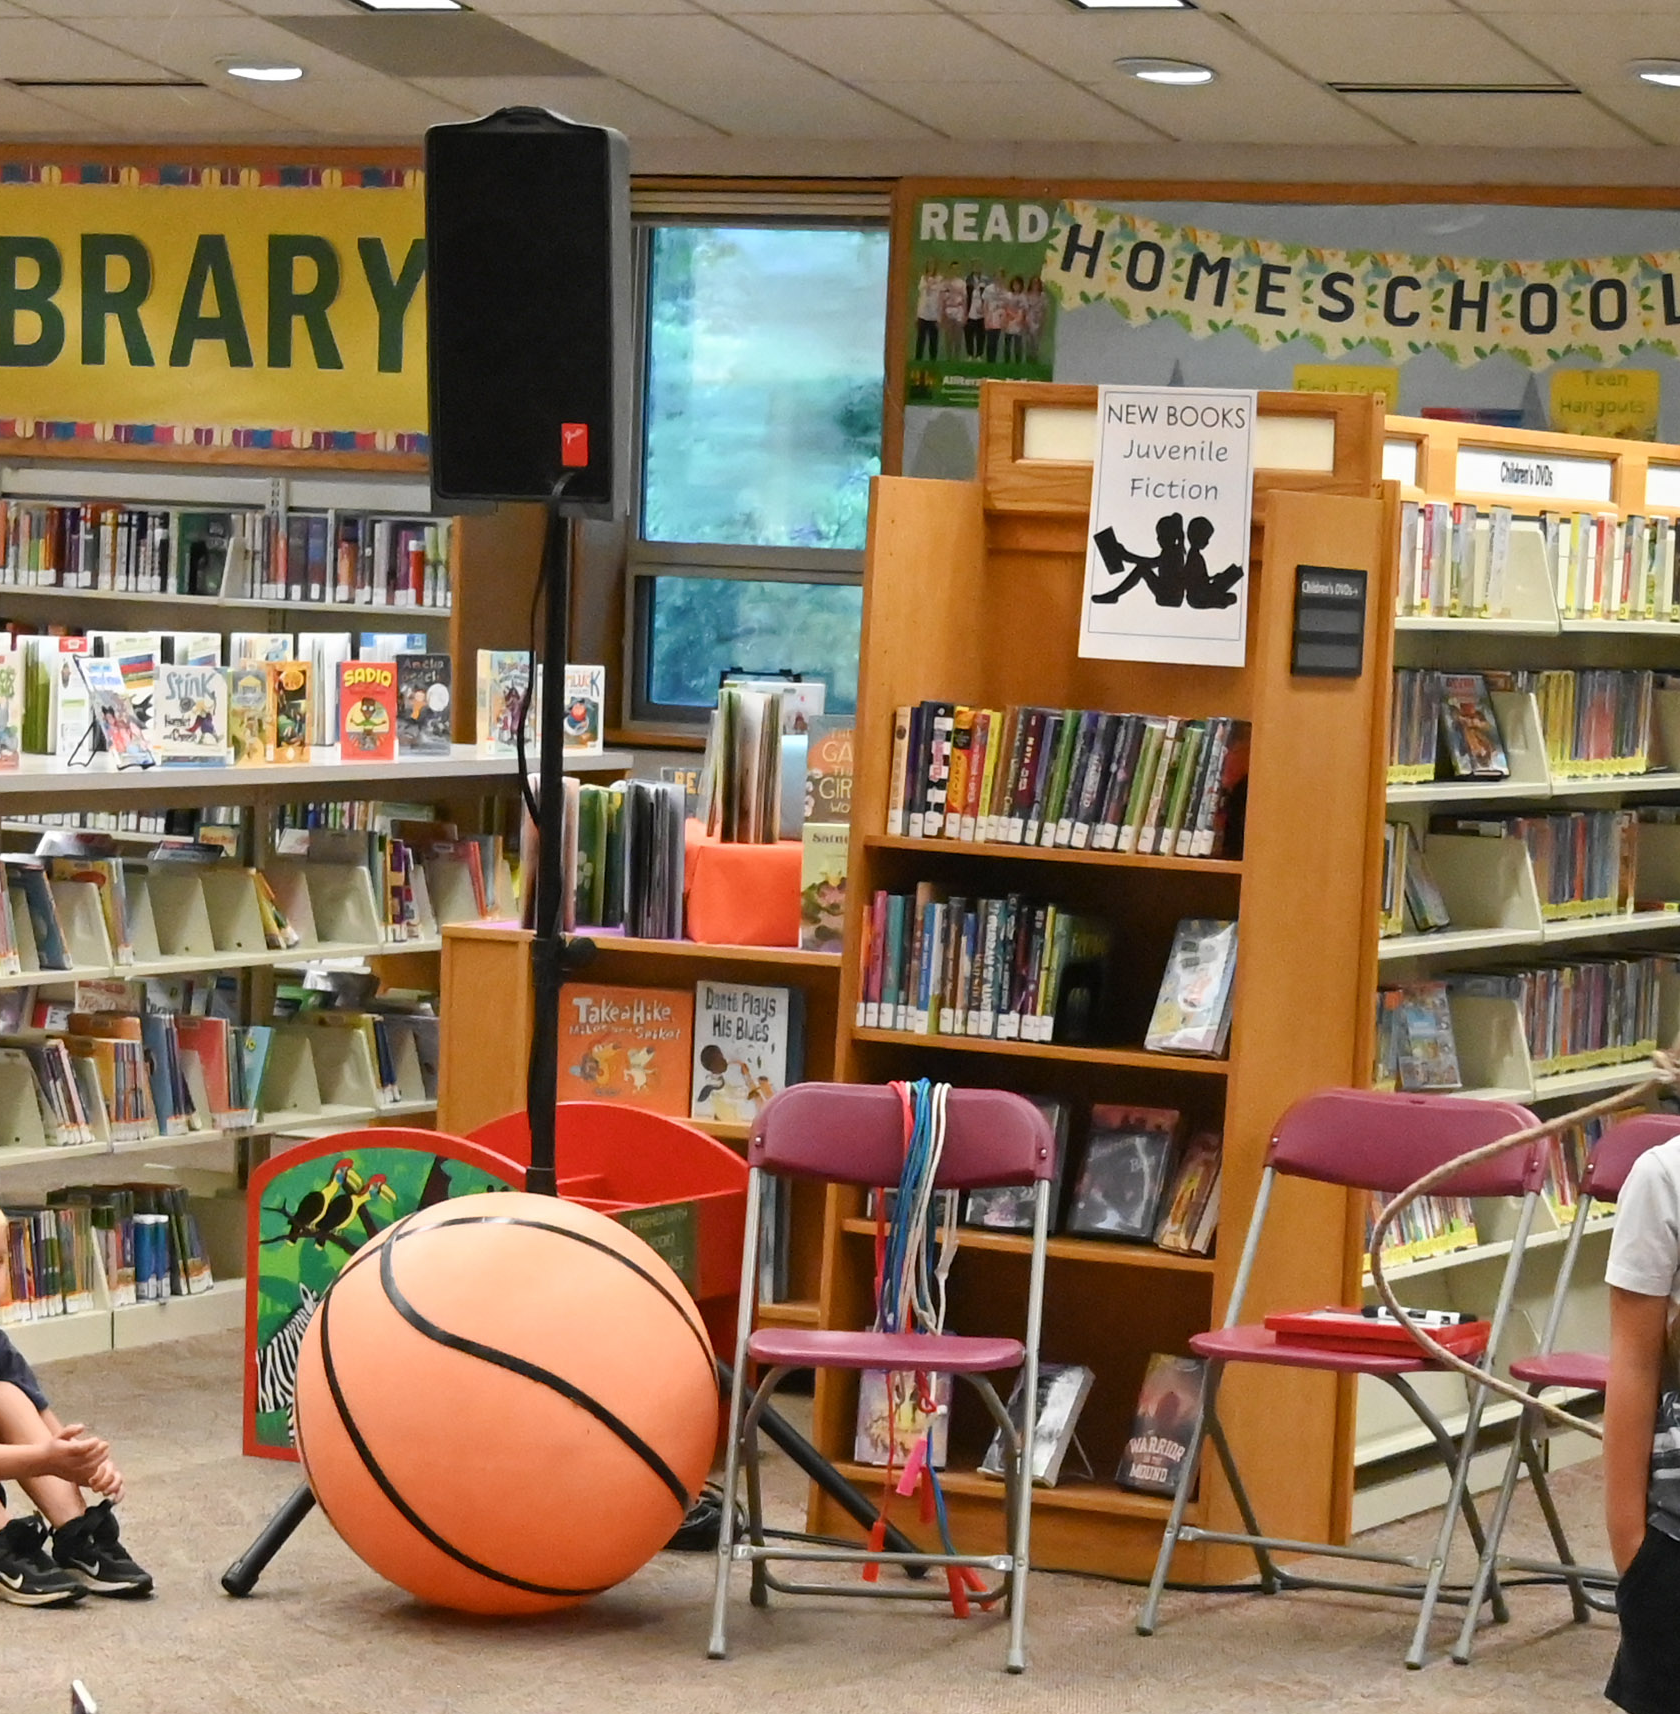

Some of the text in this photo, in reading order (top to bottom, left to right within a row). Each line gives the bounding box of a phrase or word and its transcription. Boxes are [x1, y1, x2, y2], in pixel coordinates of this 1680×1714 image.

[919, 202, 1050, 244] READ
[1582, 370, 1629, 386] Teen
[1108, 404, 1246, 429] NEW BOOKS
[1559, 399, 1645, 417] Hangouts
[1123, 439, 1228, 462] Juvenile
[1500, 461, 1553, 487] Children's DVDs
[1130, 477, 1219, 500] Fiction
[165, 671, 217, 701] Stink
[822, 741, 853, 763] GA
[819, 777, 853, 799] GIR
[573, 997, 619, 1025] Take
[620, 1006, 631, 1021] a
[741, 992, 777, 1024] Plays
[712, 1014, 769, 1043] His Blues
[1128, 1436, 1186, 1463] WARRIOR
[1128, 1462, 1169, 1483] MOUND
